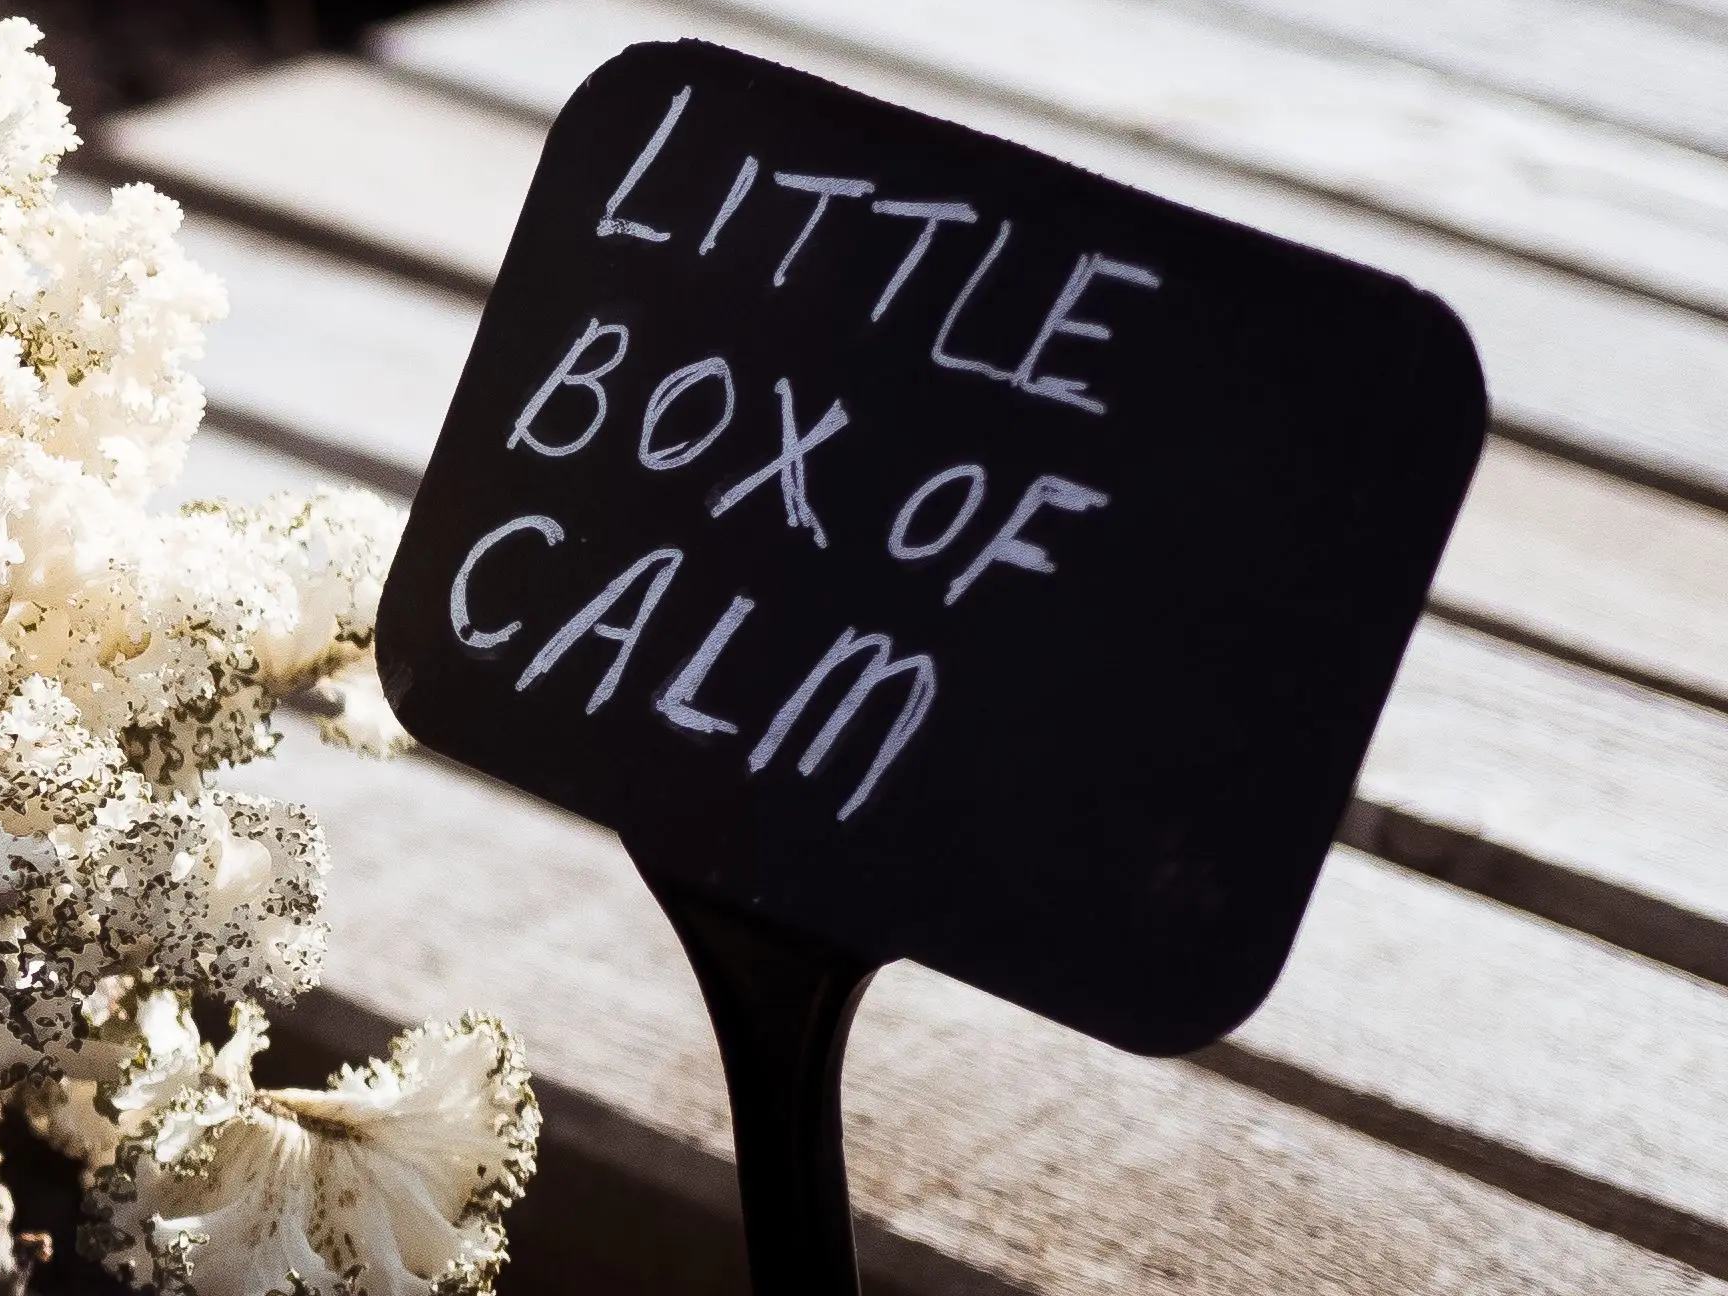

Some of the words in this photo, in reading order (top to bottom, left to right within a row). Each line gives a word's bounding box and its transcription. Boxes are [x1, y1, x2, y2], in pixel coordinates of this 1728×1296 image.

[595, 84, 1160, 415] LITTLE
[506, 316, 850, 549] BOX
[887, 463, 1108, 606] OF
[448, 512, 938, 822] CALM
